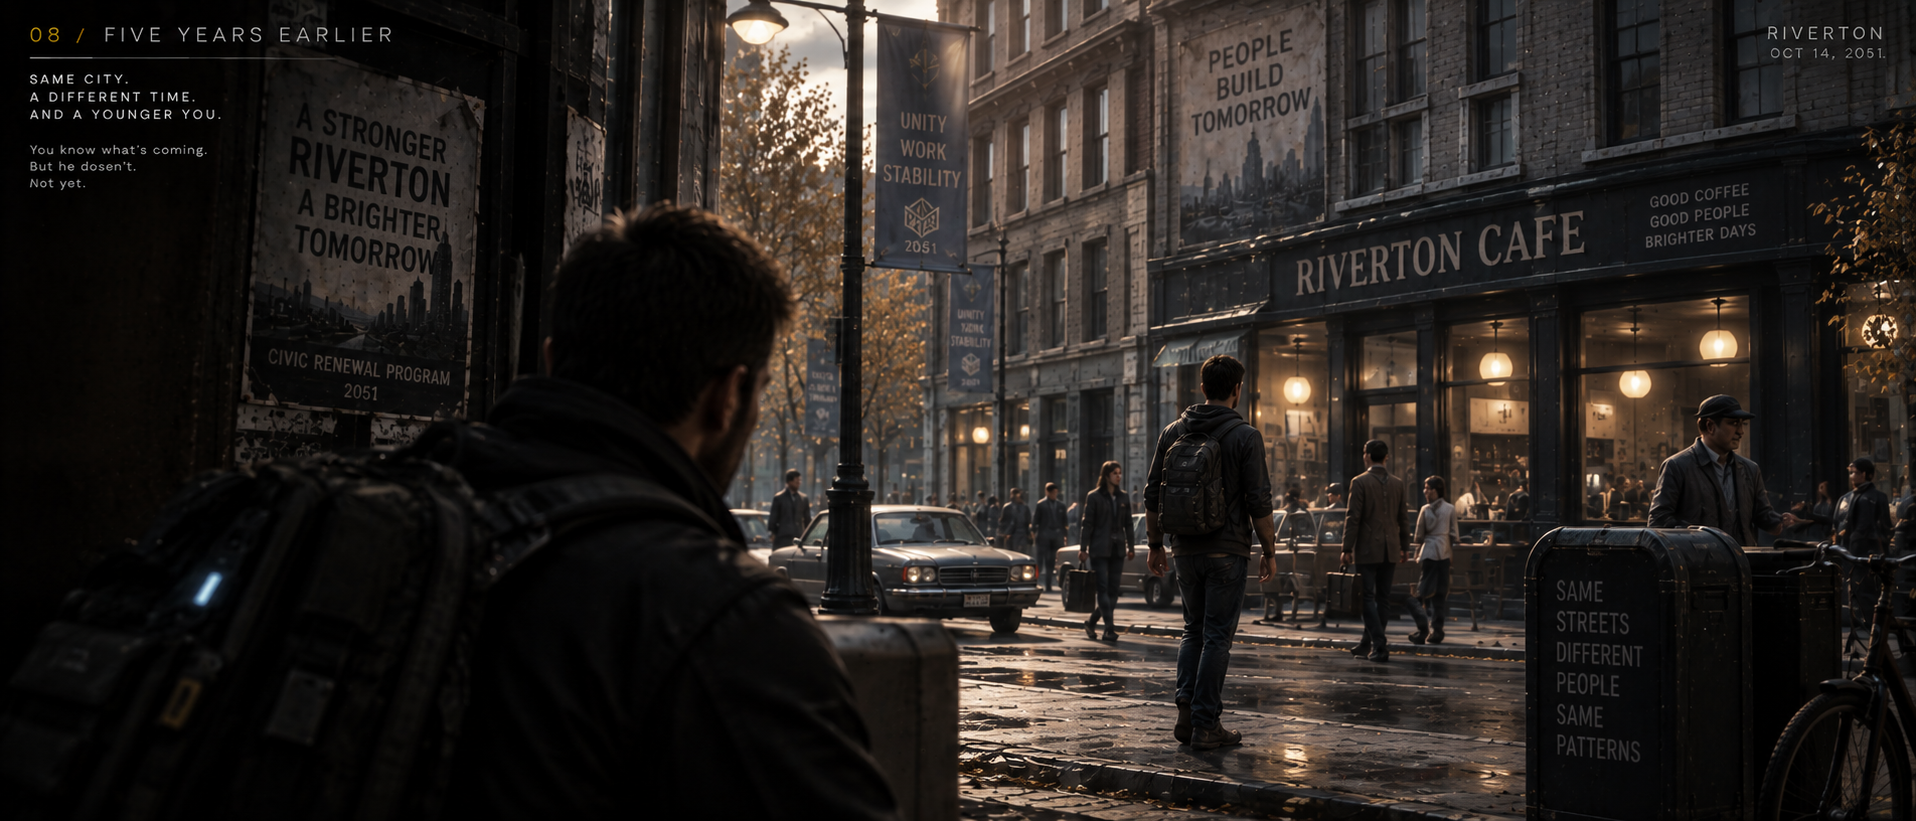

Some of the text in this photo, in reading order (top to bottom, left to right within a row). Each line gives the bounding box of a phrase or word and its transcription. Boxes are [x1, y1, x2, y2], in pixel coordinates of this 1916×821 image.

[1209, 29, 1293, 73] PEOPLE
[1217, 63, 1283, 101] BUILD
[901, 111, 947, 133] UNITY
[1191, 87, 1311, 136] TOMORROW
[296, 103, 447, 165] A STRONGER
[900, 139, 946, 161] WORK
[289, 135, 451, 208] RIVERTON
[883, 164, 961, 189] STABILITY
[1650, 183, 1749, 208] GOOD COFFEE
[298, 188, 440, 241] A BRIGHTER
[1650, 203, 1749, 228] GOOD PEOPLE
[904, 240, 937, 254] 2051
[1645, 223, 1756, 248] BRIGHTER DAYS
[295, 224, 439, 275] TOMORROW
[1296, 210, 1585, 296] RIVERTON CAFE
[268, 348, 451, 386] CIVIC RENEWAL PROGRAM
[343, 383, 378, 402] 2051
[1556, 579, 1604, 603] SAME
[1556, 611, 1630, 635] STREETS
[1556, 642, 1643, 668] DIFFERENT
[1556, 672, 1620, 698] PEOPLE
[1556, 703, 1604, 728] SAME
[1556, 734, 1641, 763] PATTERNS
